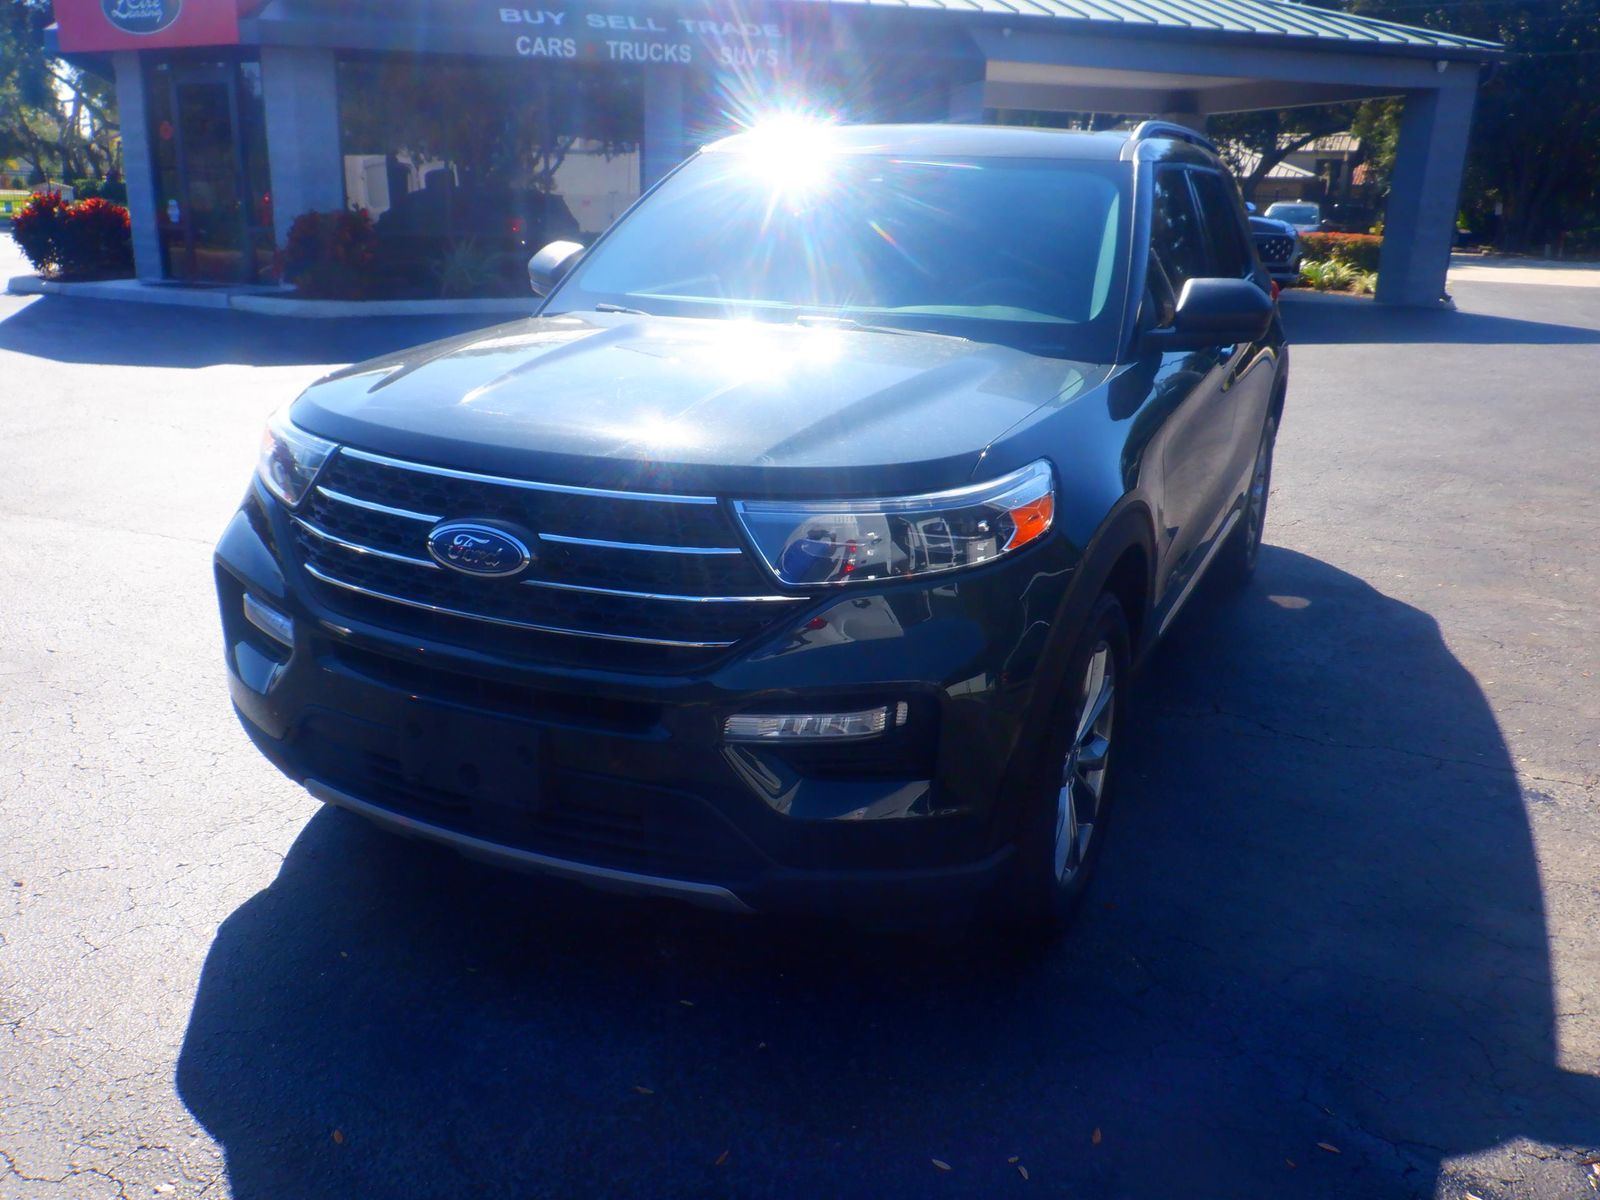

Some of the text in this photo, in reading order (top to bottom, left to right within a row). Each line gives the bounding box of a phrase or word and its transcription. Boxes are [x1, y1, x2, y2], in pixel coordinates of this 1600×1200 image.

[499, 8, 783, 38] BUY SELL TRADE
[515, 36, 577, 57] CARS
[606, 40, 692, 63] TRUCKS
[445, 533, 503, 567] Ford
